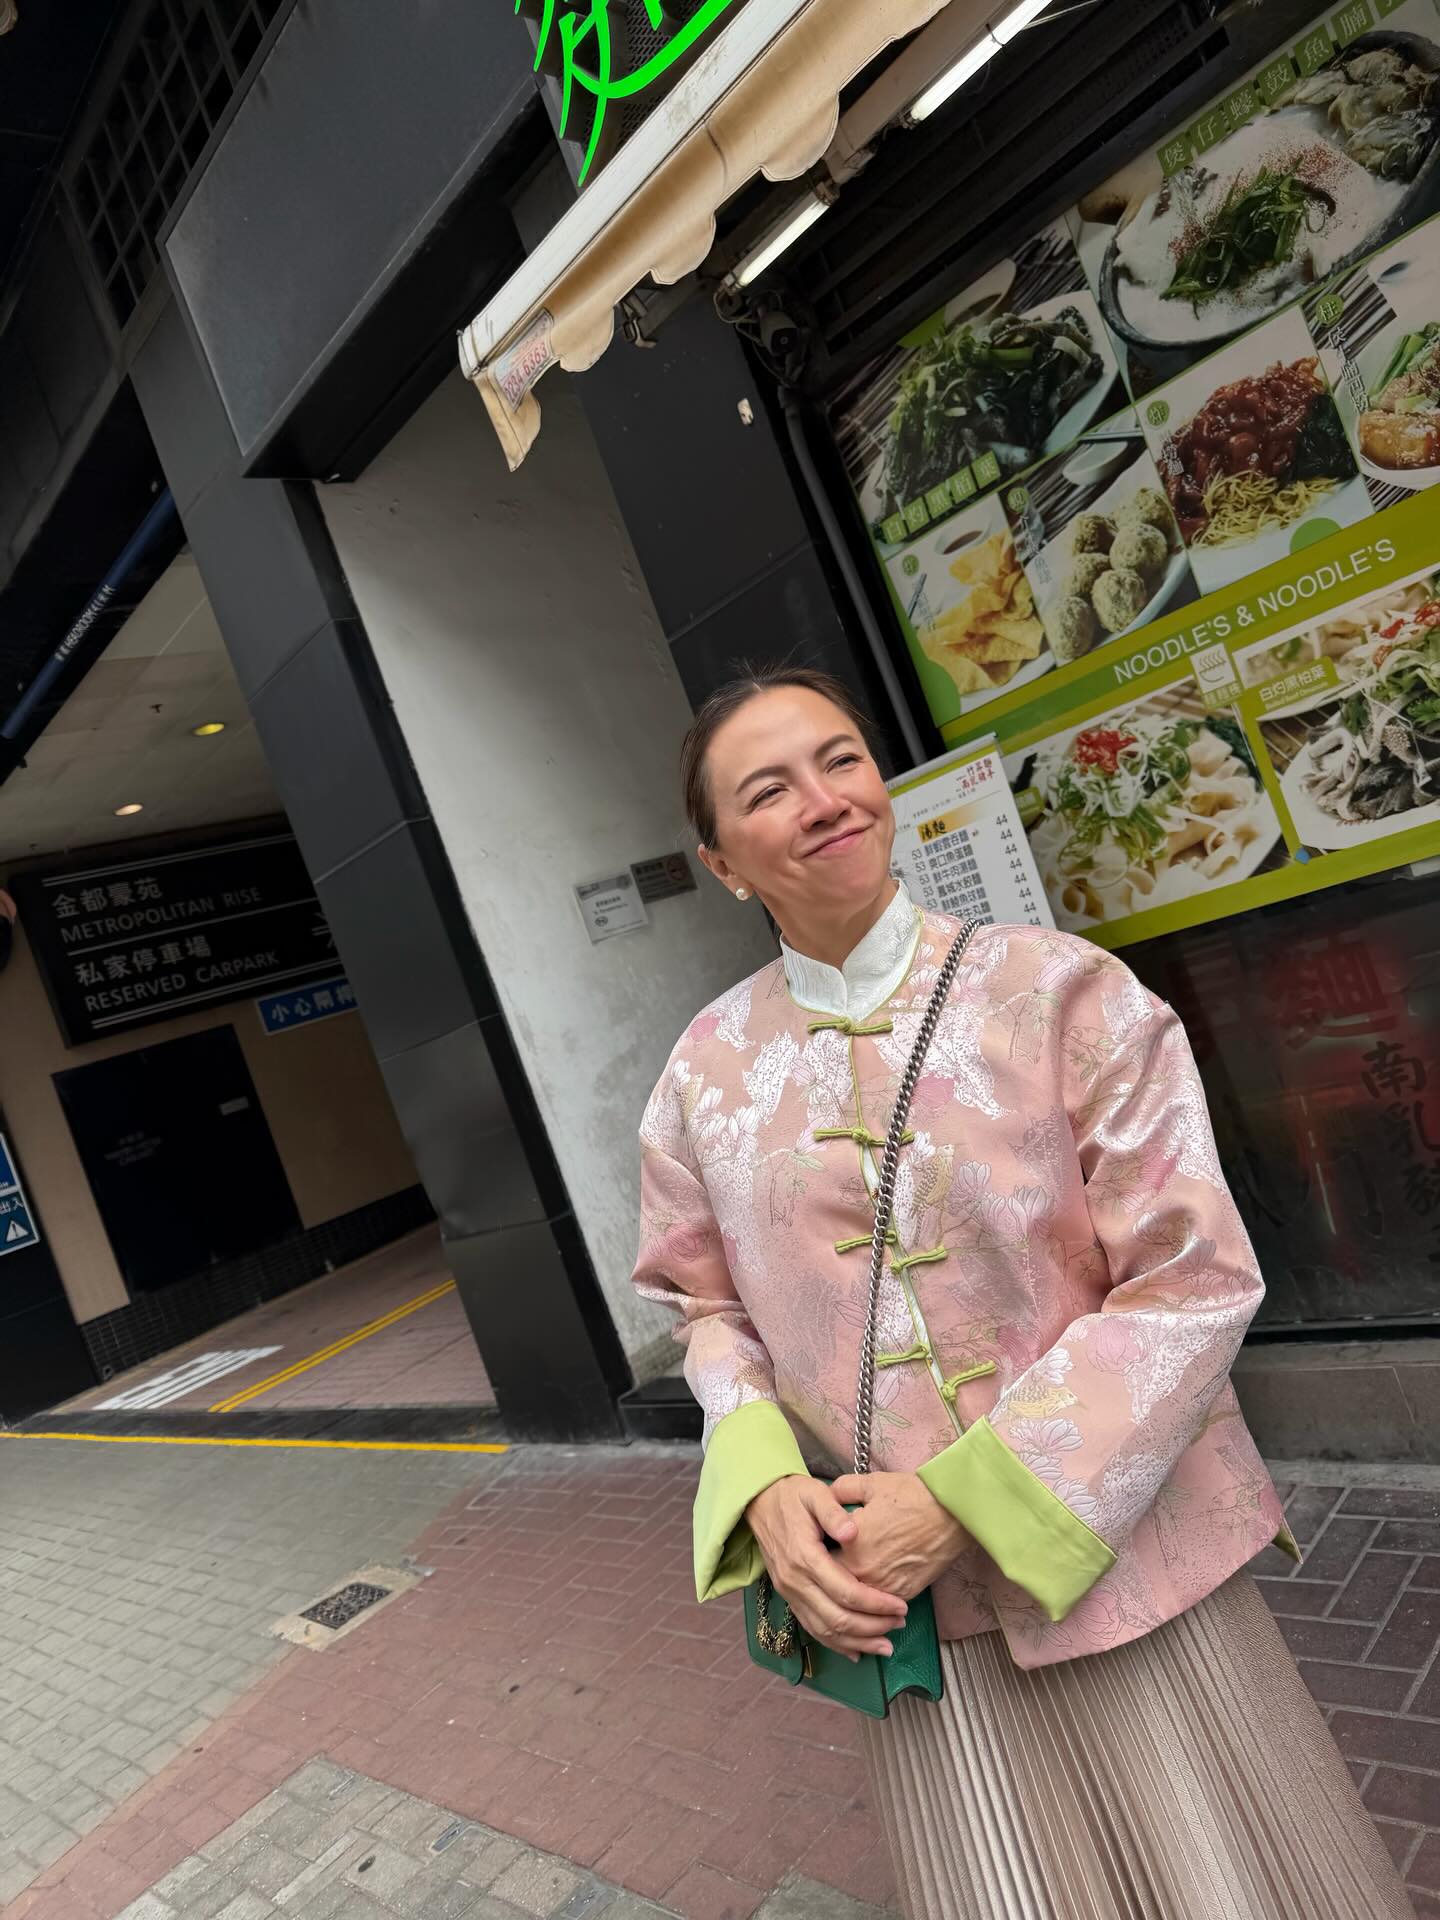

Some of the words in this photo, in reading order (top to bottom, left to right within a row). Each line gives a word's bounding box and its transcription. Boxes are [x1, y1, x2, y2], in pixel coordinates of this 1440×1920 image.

[1113, 616, 1231, 684] NOODLE'S
[1237, 604, 1254, 627] &
[1257, 539, 1396, 617] NOODLE'S
[996, 814, 1008, 825] 44
[1001, 828, 1012, 840] 44
[1005, 843, 1017, 855] 44
[1010, 858, 1022, 869] 44
[1014, 873, 1027, 884] 44
[52, 877, 163, 918] 金都豪苑
[1019, 887, 1032, 898] 44
[1024, 902, 1037, 913] 44
[61, 898, 215, 944] METROPOLITAN
[223, 887, 263, 907] RISE
[74, 935, 212, 987] 私家停車場
[85, 973, 187, 1012] RESERVED
[196, 951, 280, 983] CARPARK
